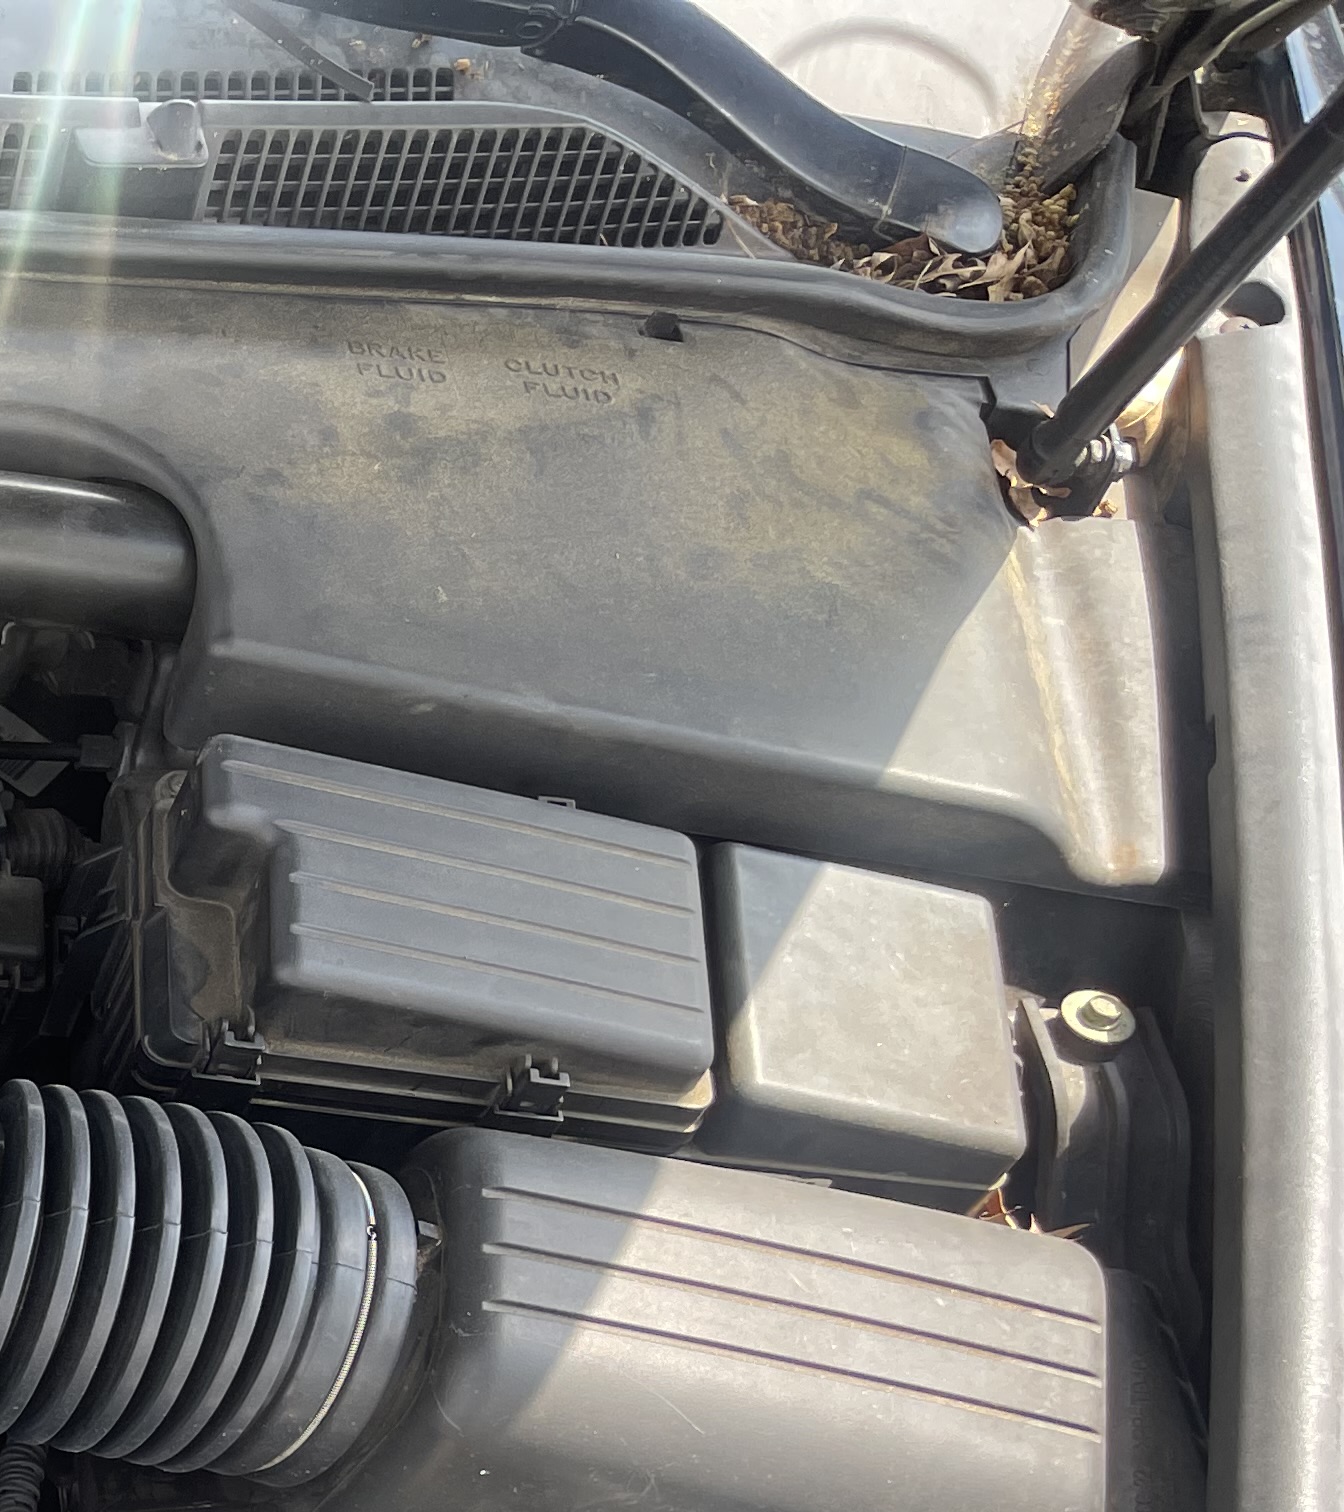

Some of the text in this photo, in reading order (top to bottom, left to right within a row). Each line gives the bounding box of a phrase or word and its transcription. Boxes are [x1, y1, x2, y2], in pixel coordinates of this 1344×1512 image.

[346, 340, 448, 365] BRAKE
[357, 361, 447, 384] FLUID
[503, 358, 620, 386] CLUTCH
[523, 380, 613, 404] FLUID
